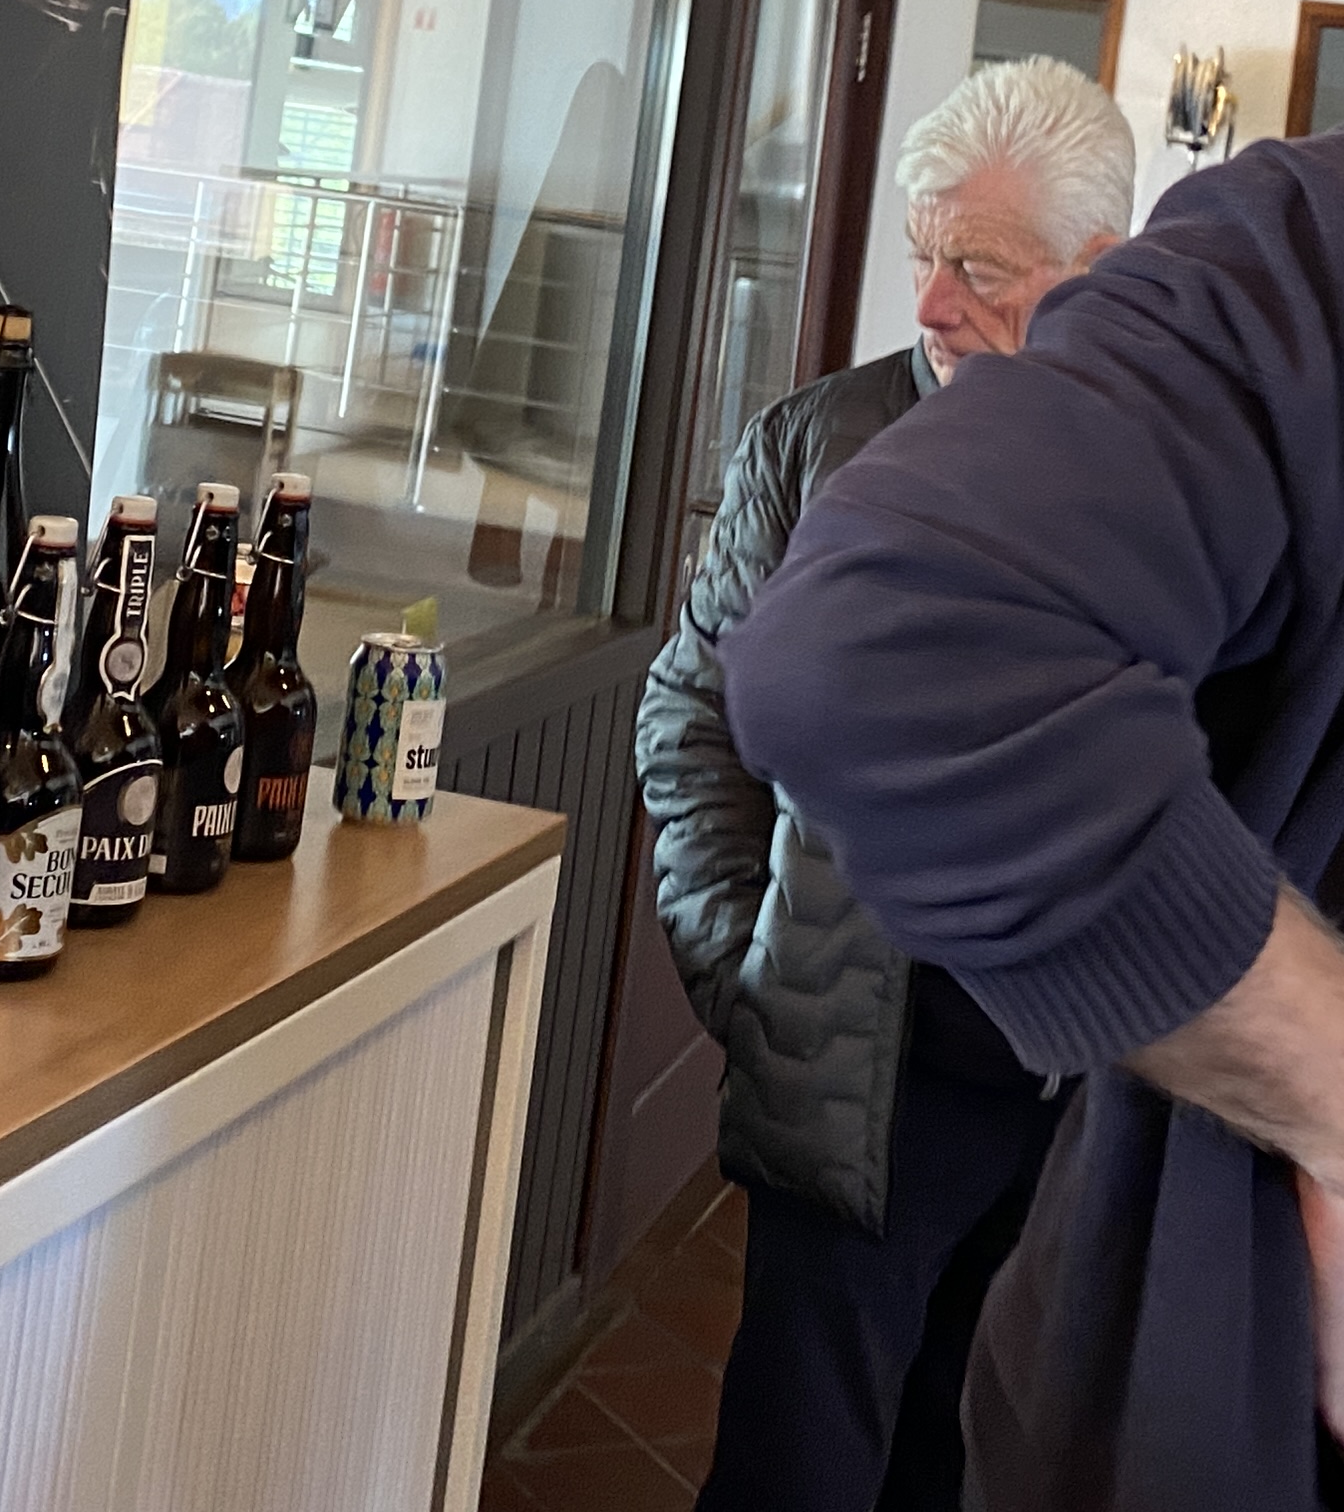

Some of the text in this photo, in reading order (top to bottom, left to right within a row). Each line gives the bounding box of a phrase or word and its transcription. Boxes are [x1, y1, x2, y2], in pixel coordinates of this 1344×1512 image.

[126, 552, 149, 618] TRIPLE
[406, 744, 436, 769] stu
[80, 836, 135, 861] PAIX
